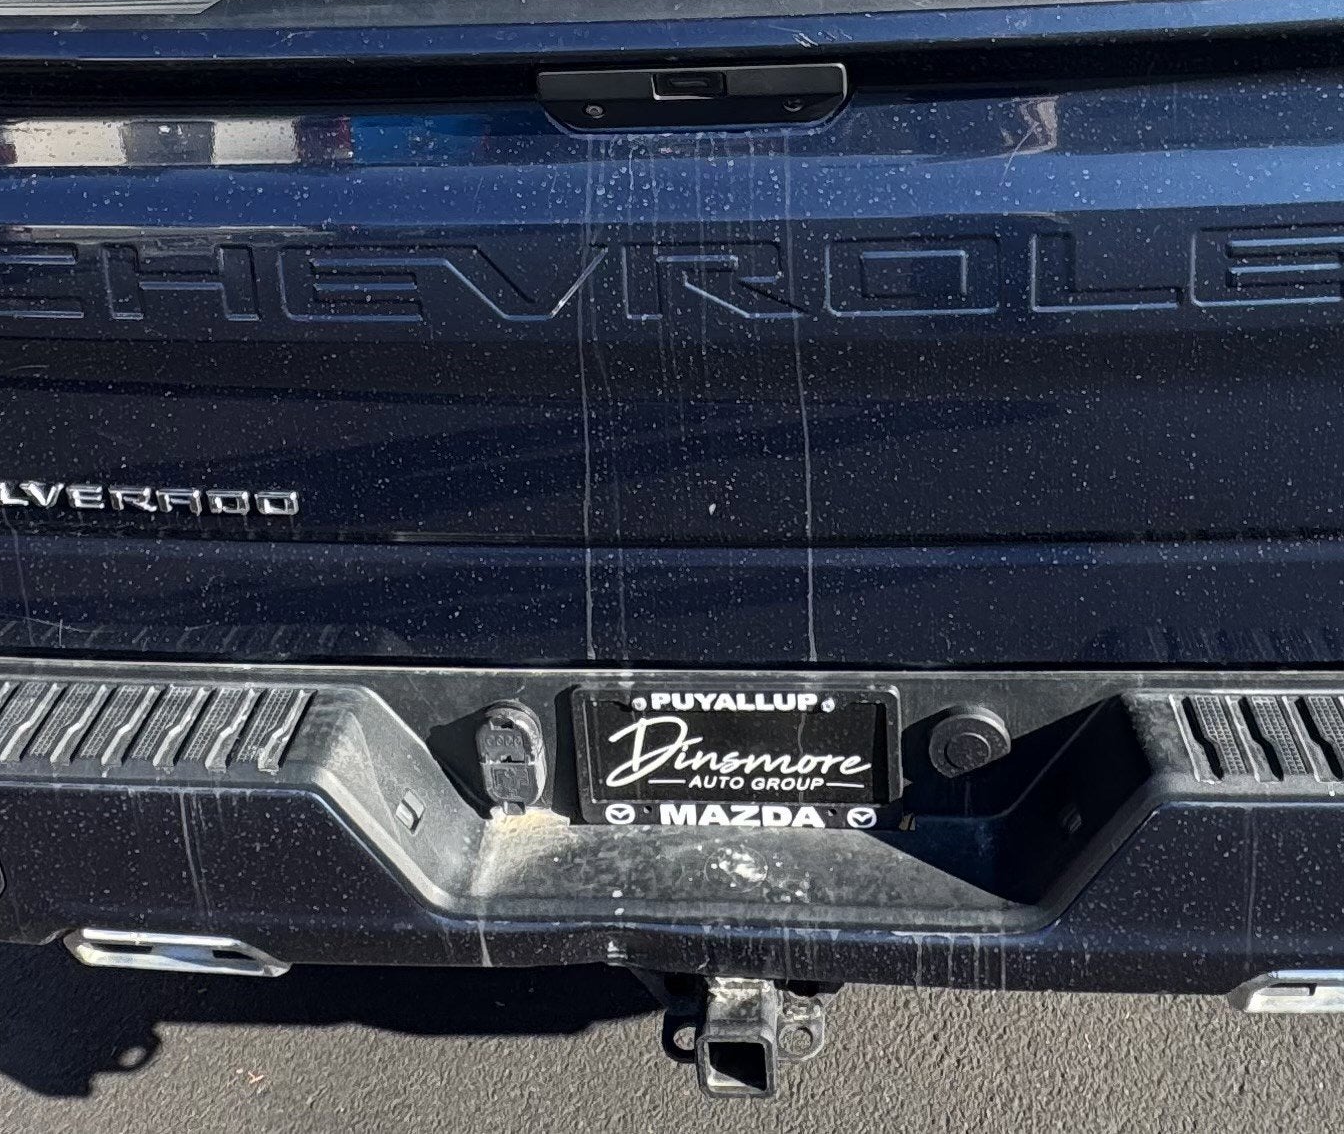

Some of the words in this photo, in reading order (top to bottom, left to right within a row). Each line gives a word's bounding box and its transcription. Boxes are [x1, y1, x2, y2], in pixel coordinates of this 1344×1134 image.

[650, 692, 819, 712] PUYALLUP
[606, 716, 872, 788] Dinsmore
[688, 775, 746, 790] AUTO
[751, 776, 825, 791] GROUP
[659, 803, 826, 829] MAZDA
